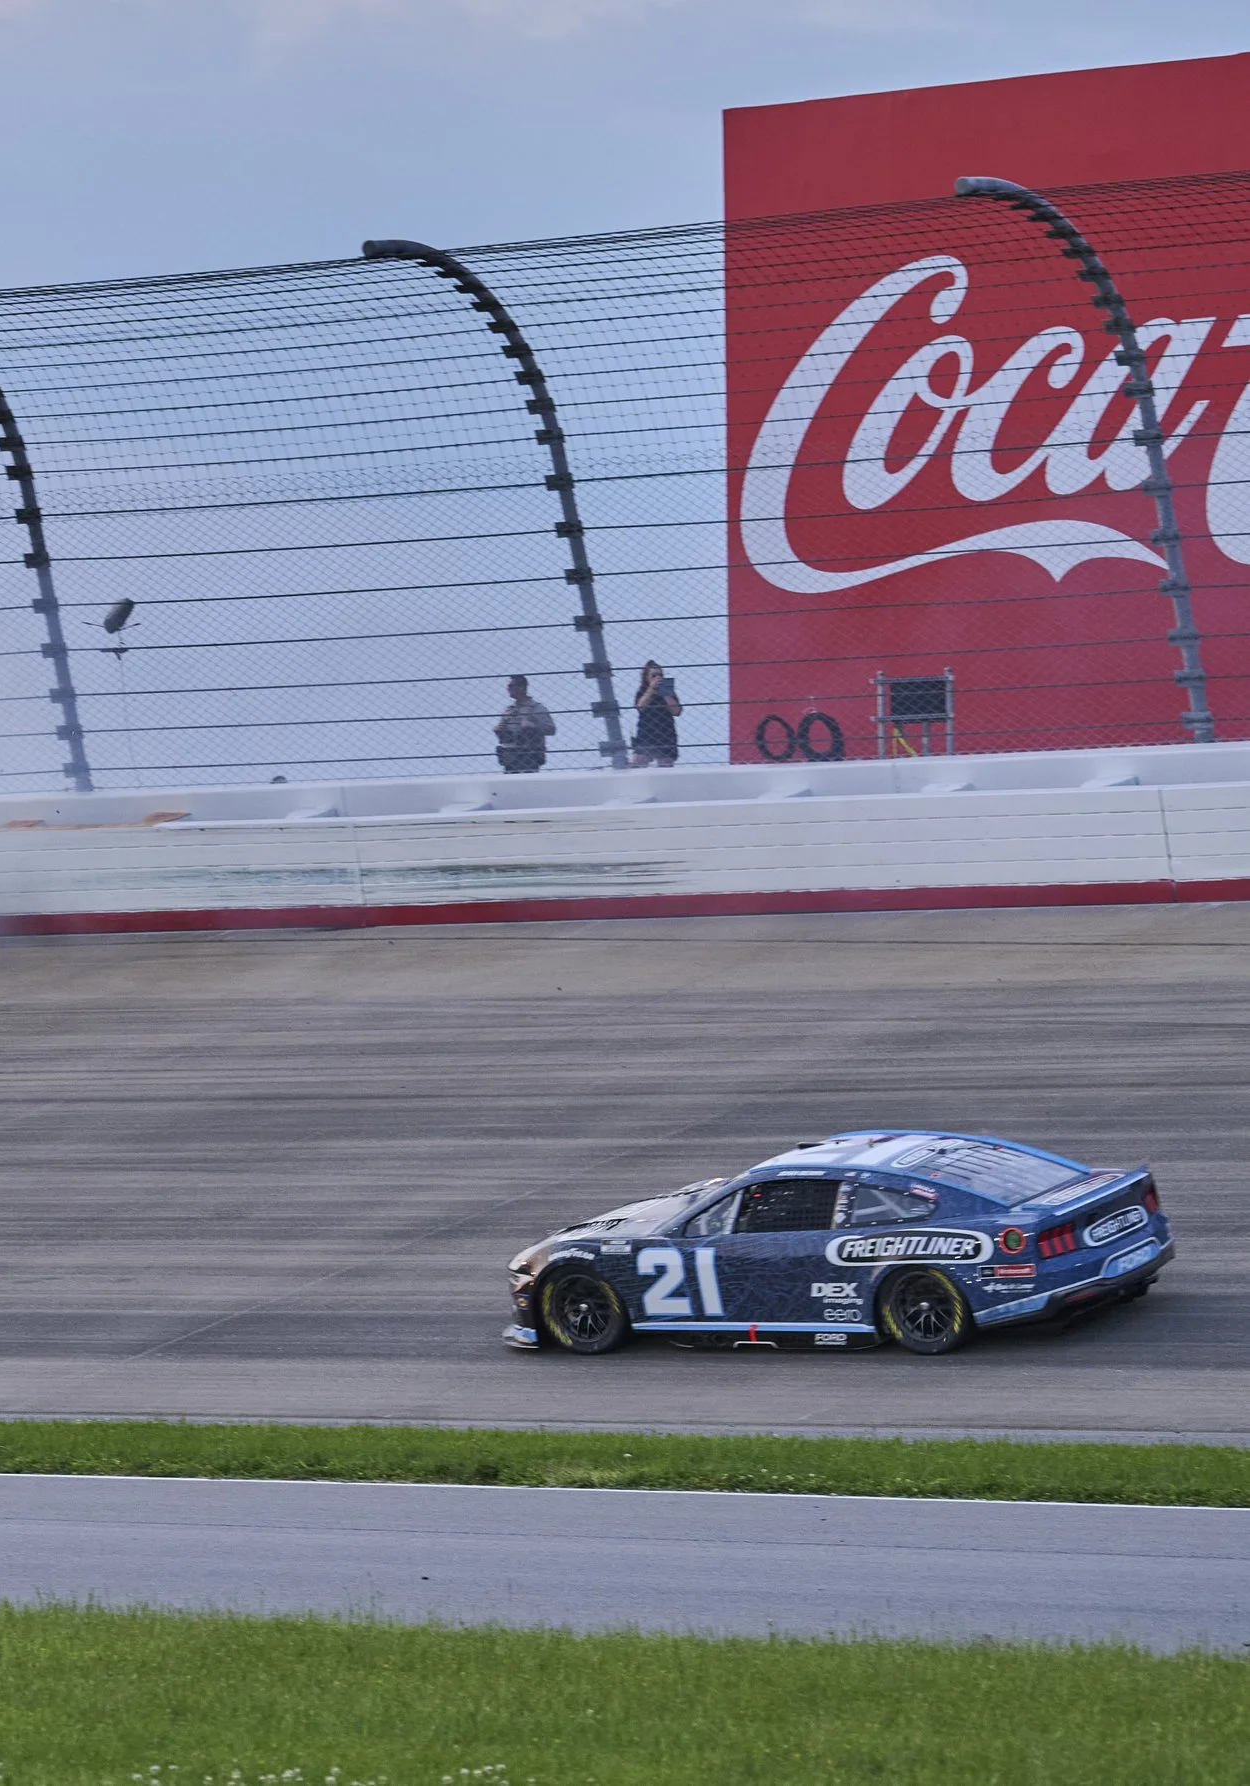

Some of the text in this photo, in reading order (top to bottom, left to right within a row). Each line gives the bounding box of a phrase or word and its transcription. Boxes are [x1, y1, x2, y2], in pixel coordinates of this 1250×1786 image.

[841, 1236, 977, 1259] FREIGHTLINER
[636, 1247, 727, 1317] 21
[810, 1282, 859, 1297] DEX
[823, 1308, 863, 1322] eero
[814, 1333, 847, 1341] FORD
